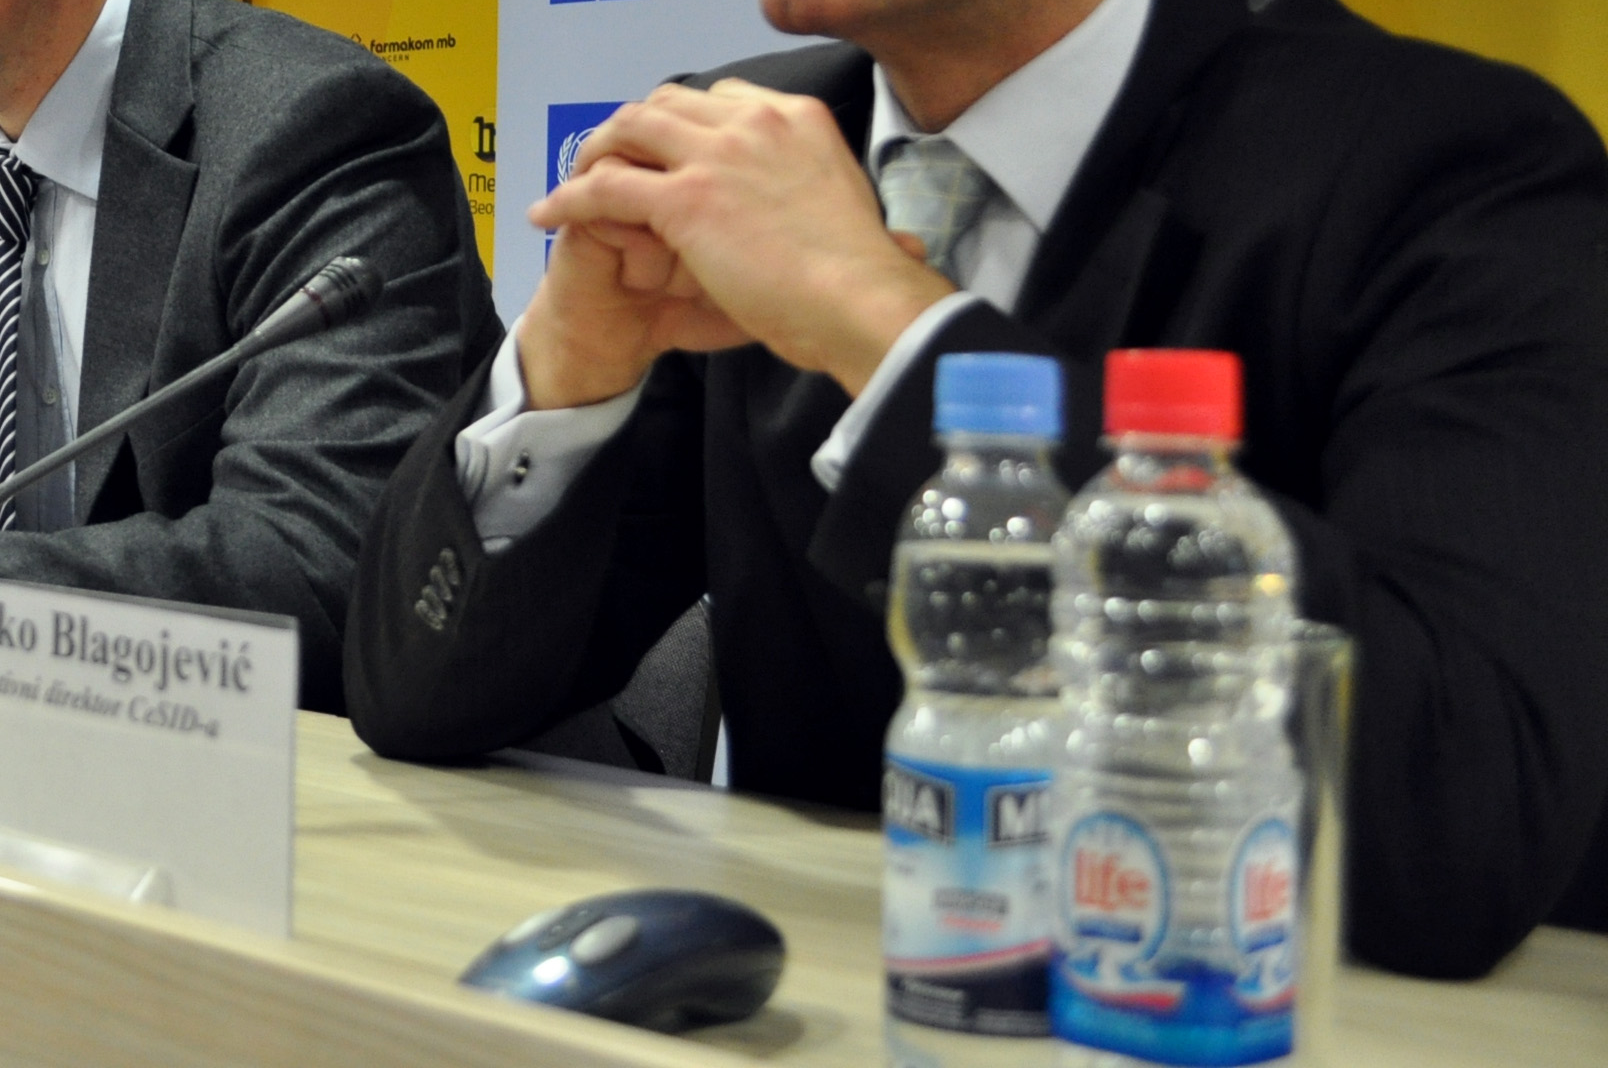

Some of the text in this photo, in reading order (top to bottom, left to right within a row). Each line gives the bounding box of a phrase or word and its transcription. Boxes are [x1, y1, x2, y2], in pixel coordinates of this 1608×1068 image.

[370, 34, 456, 53] farmakom mb
[50, 609, 253, 692] Blagojević
[44, 678, 122, 718] direktor
[1074, 847, 1151, 911] Life
